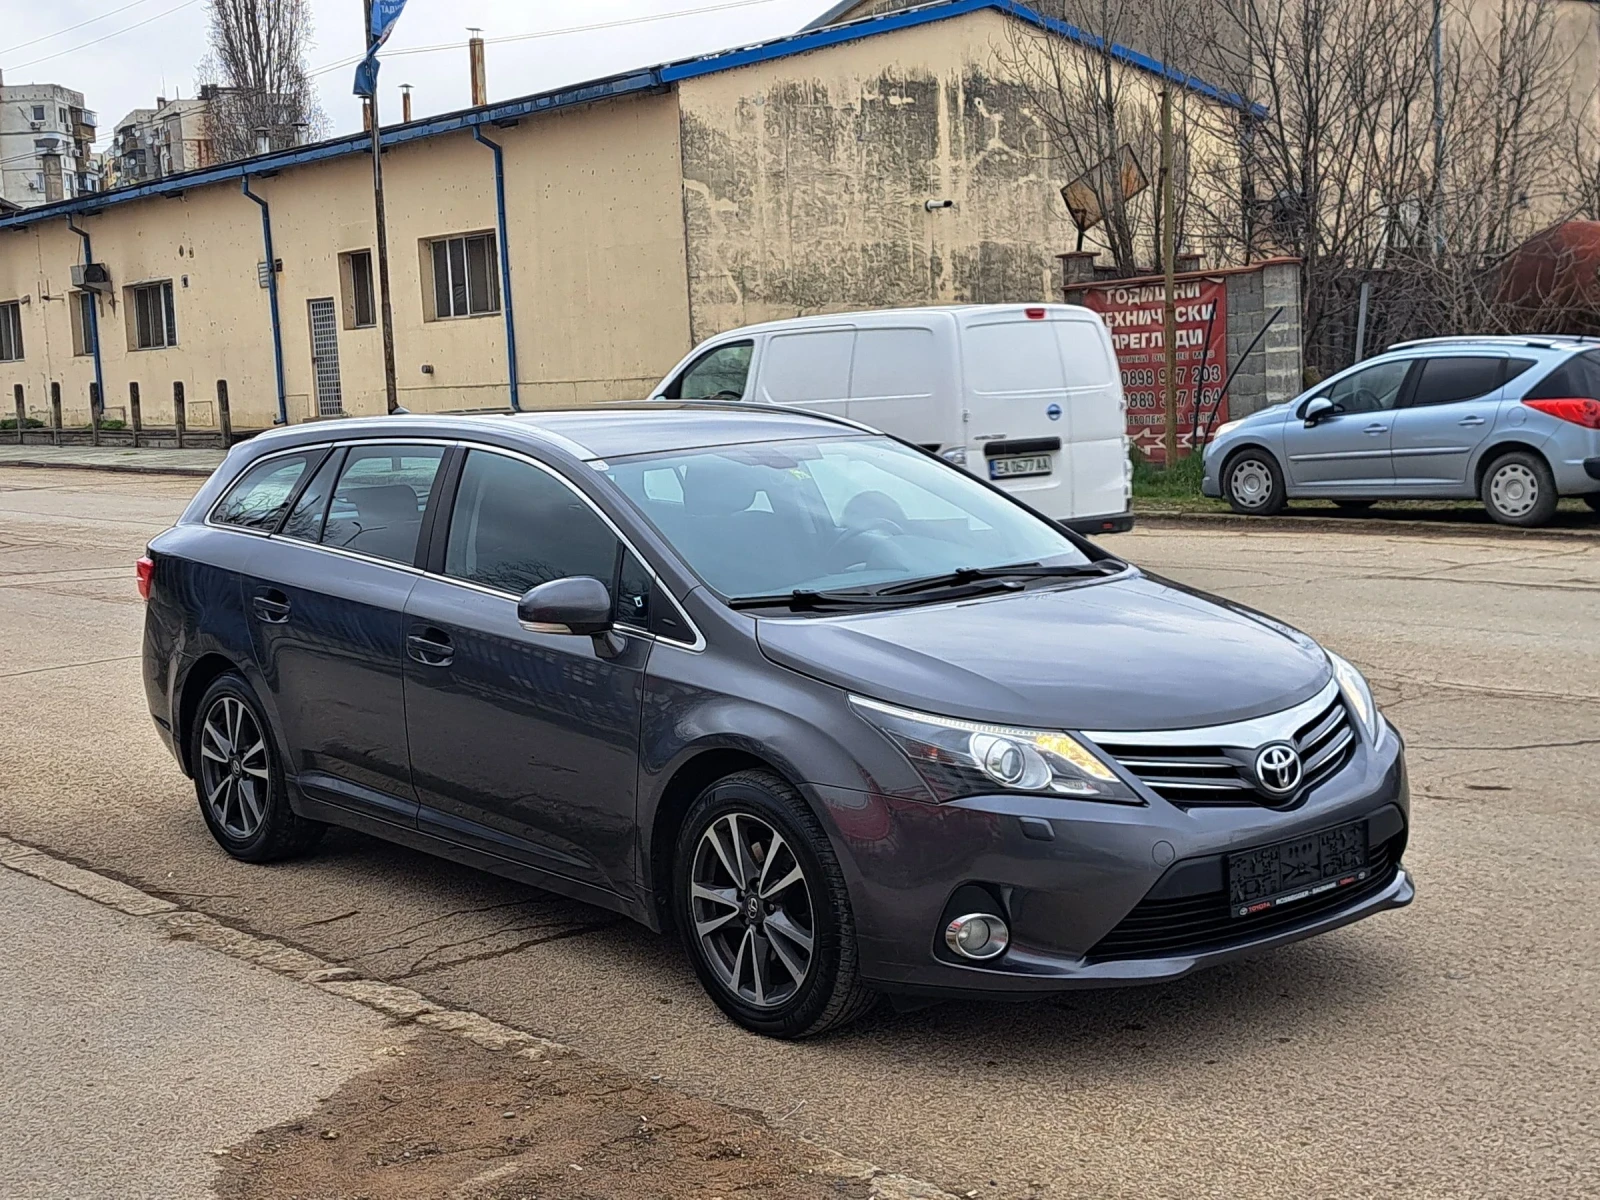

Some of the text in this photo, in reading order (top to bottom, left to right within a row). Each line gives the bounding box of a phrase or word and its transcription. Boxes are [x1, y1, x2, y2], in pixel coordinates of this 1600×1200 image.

[1099, 303, 1217, 327] ТЕХНИЧСКИ
[1111, 328, 1203, 350] ПРЕГЛДИ
[1121, 364, 1222, 387] 0898 97 203
[1159, 389, 1187, 408] 37
[1248, 902, 1271, 913] TOYOTA
